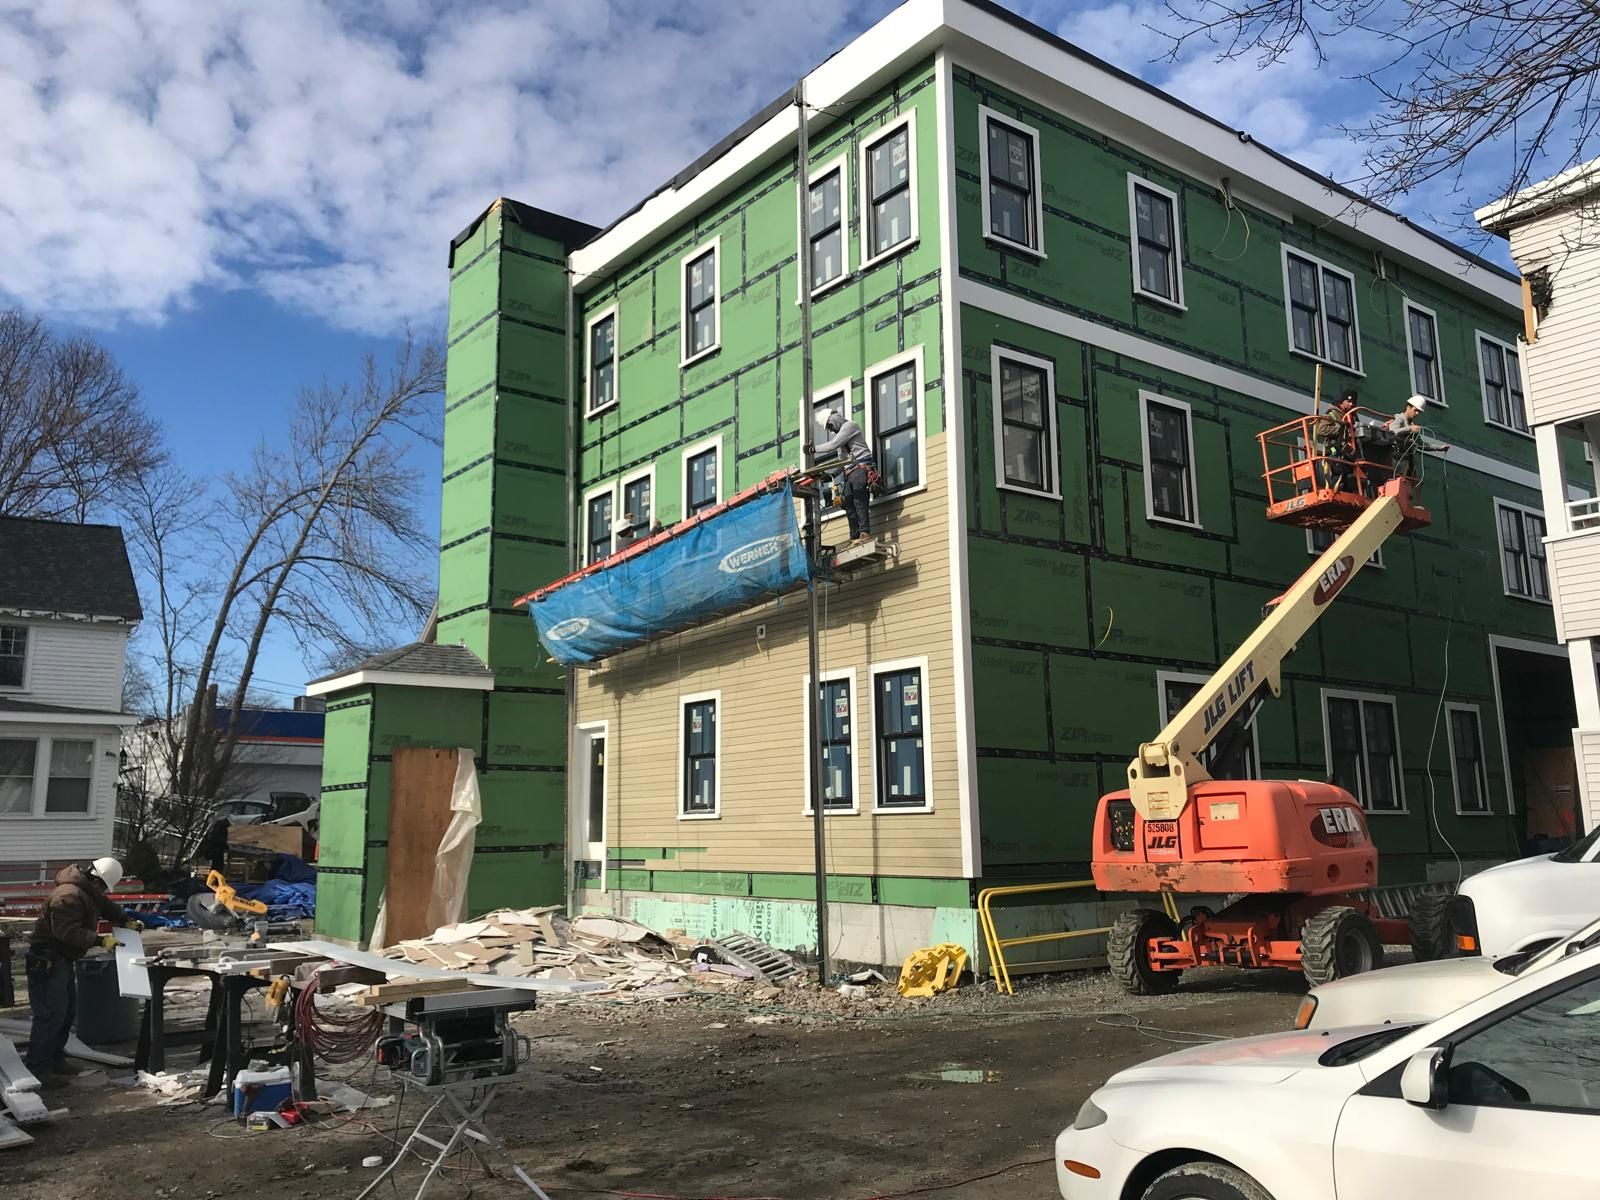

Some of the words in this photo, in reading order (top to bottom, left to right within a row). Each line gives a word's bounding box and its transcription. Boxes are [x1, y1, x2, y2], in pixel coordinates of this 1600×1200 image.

[1014, 508, 1041, 523] ZIP
[729, 541, 779, 569] WERNER
[1318, 558, 1348, 593] ERA
[1009, 661, 1039, 676] ZIP
[1203, 691, 1227, 735] JLG
[1227, 660, 1255, 706] LIFT
[379, 734, 412, 746] ZIP
[1060, 726, 1088, 741] ZIP
[492, 744, 522, 756] ZIP
[1064, 771, 1092, 788] ZIP
[1147, 823, 1175, 833] 525808
[1318, 807, 1361, 834] ERA
[1147, 836, 1177, 849] JLG
[838, 882, 866, 897] ZIP
[753, 900, 764, 942] King
